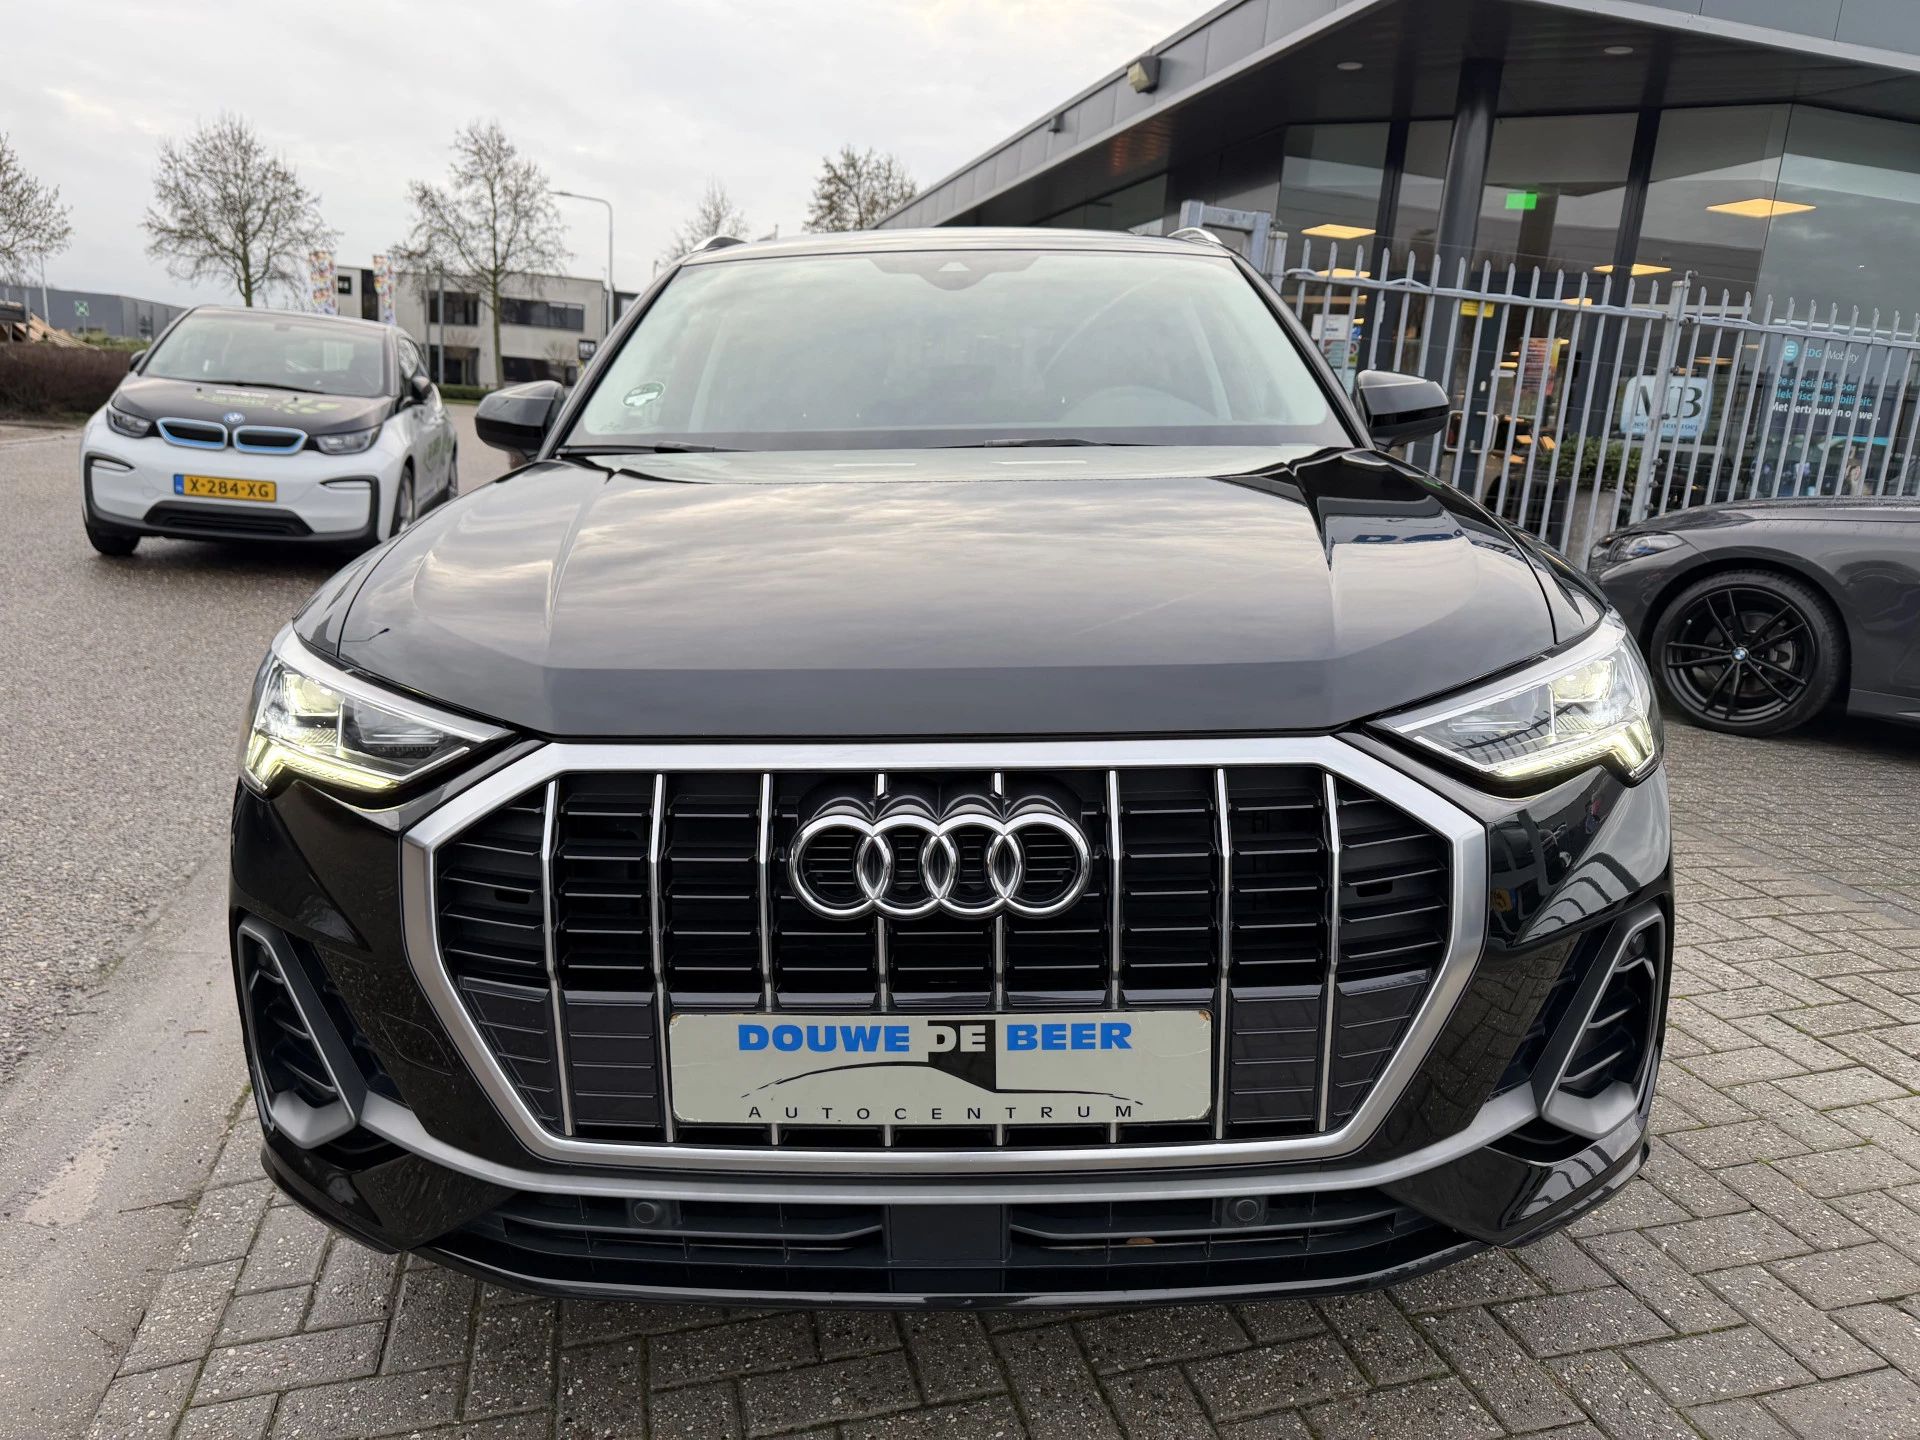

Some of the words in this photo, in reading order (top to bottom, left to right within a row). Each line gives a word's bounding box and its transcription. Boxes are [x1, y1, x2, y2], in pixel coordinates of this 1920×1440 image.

[190, 477, 270, 498] X-284-XG
[738, 1024, 910, 1052] DOUWE
[928, 1025, 986, 1052] DE
[1007, 1022, 1133, 1051] BEER
[748, 1105, 1132, 1120] AUTOCENTRUM
